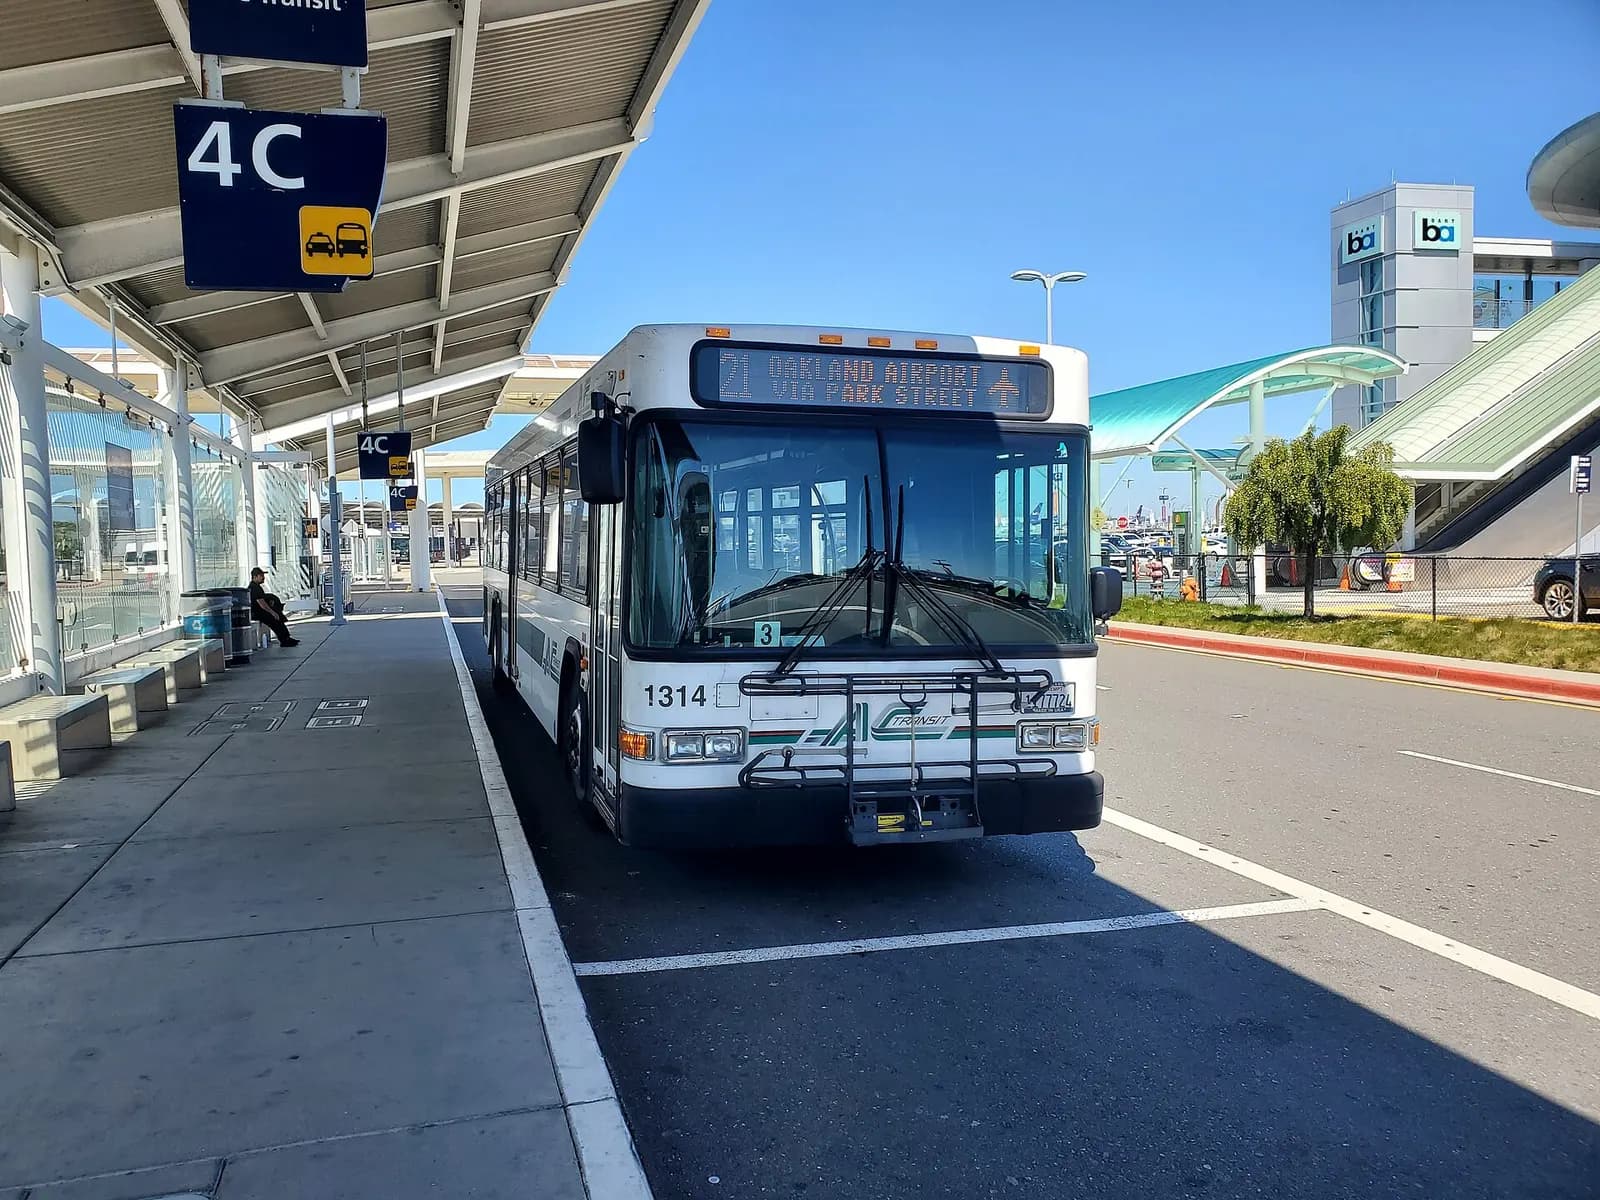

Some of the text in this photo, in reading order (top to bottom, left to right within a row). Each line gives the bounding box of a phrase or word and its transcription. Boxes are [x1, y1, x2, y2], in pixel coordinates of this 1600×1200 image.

[187, 121, 305, 189] 4C
[719, 353, 752, 398] 21
[769, 355, 981, 386] OAKLAND AIRPORT
[771, 380, 977, 407] VIA PARK STREET
[360, 436, 389, 454] 4C
[390, 487, 407, 498] 4C
[760, 623, 773, 645] 3
[644, 684, 707, 708] 1314
[1026, 693, 1072, 708] 177724
[893, 715, 951, 726] TRANSIT
